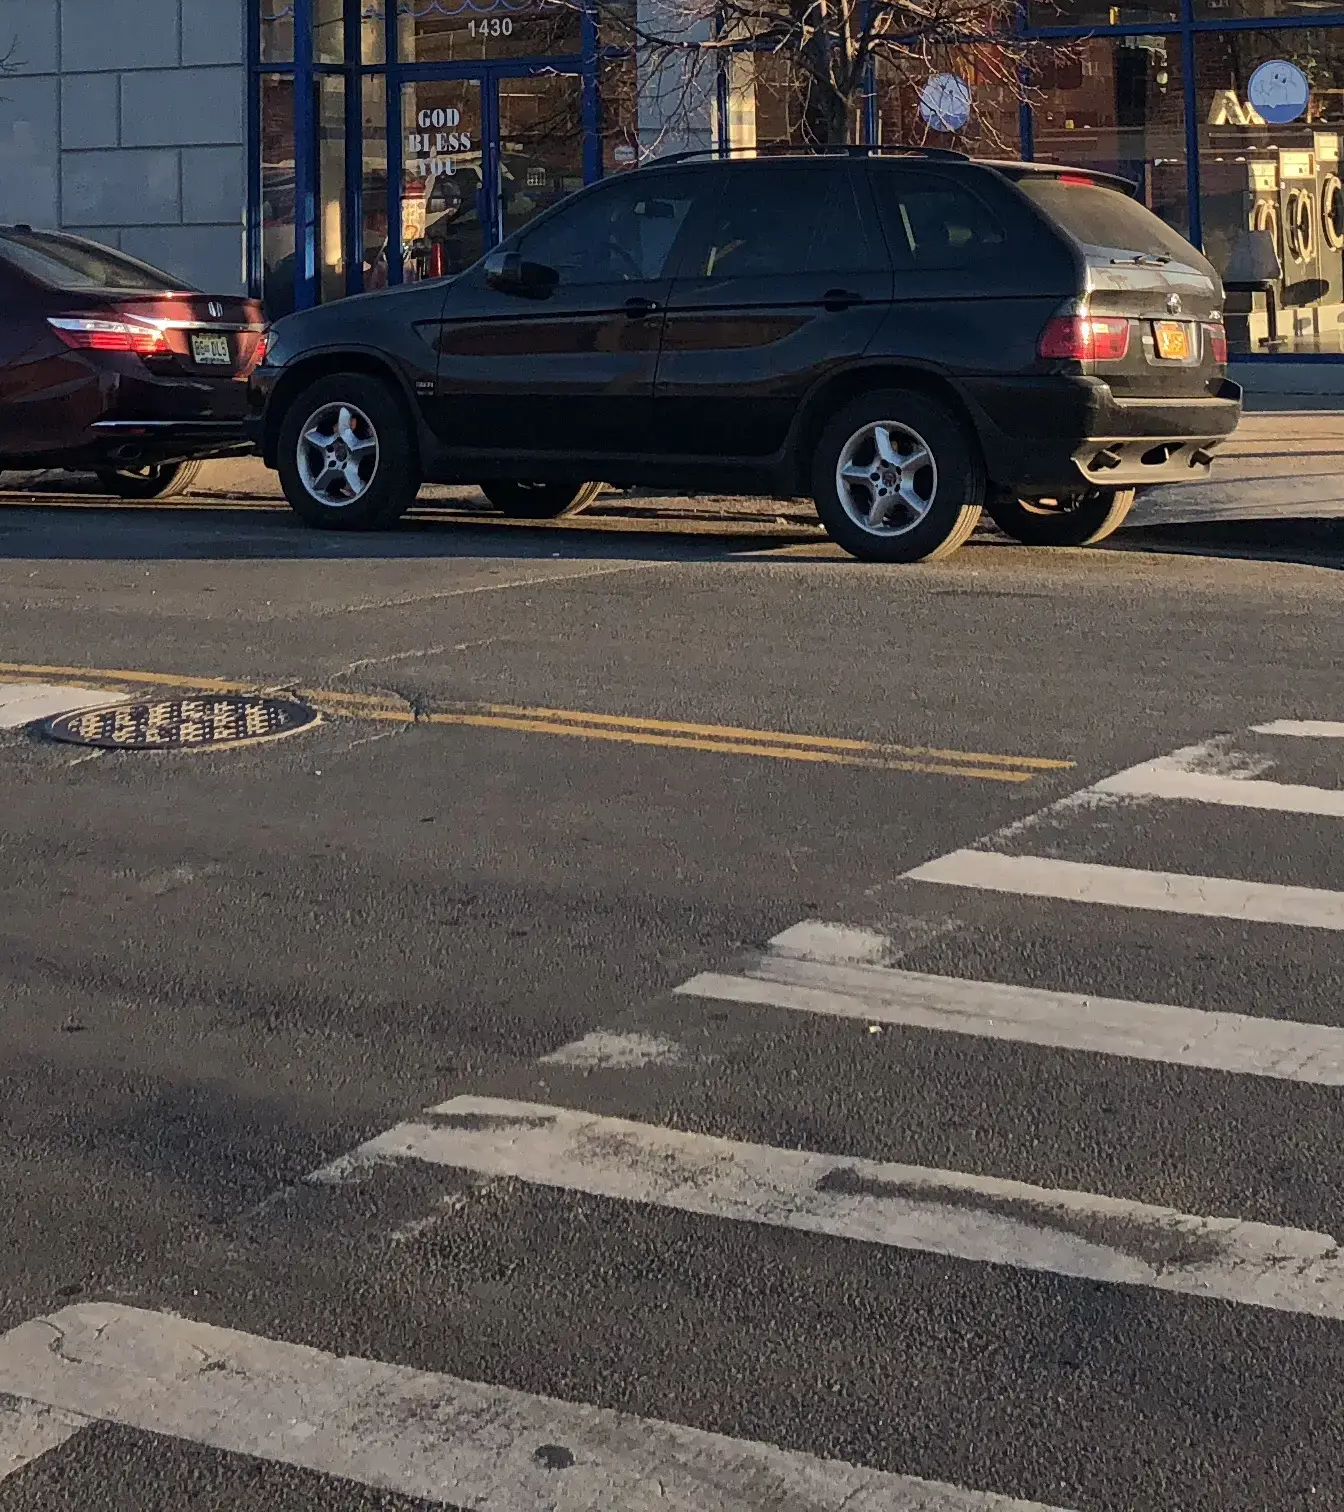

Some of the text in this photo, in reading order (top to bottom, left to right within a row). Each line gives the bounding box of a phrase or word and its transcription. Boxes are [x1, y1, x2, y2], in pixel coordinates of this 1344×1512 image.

[468, 17, 513, 38] 1430
[418, 108, 460, 129] GOD
[408, 131, 472, 153] BLESS
[419, 157, 457, 177] YOU
